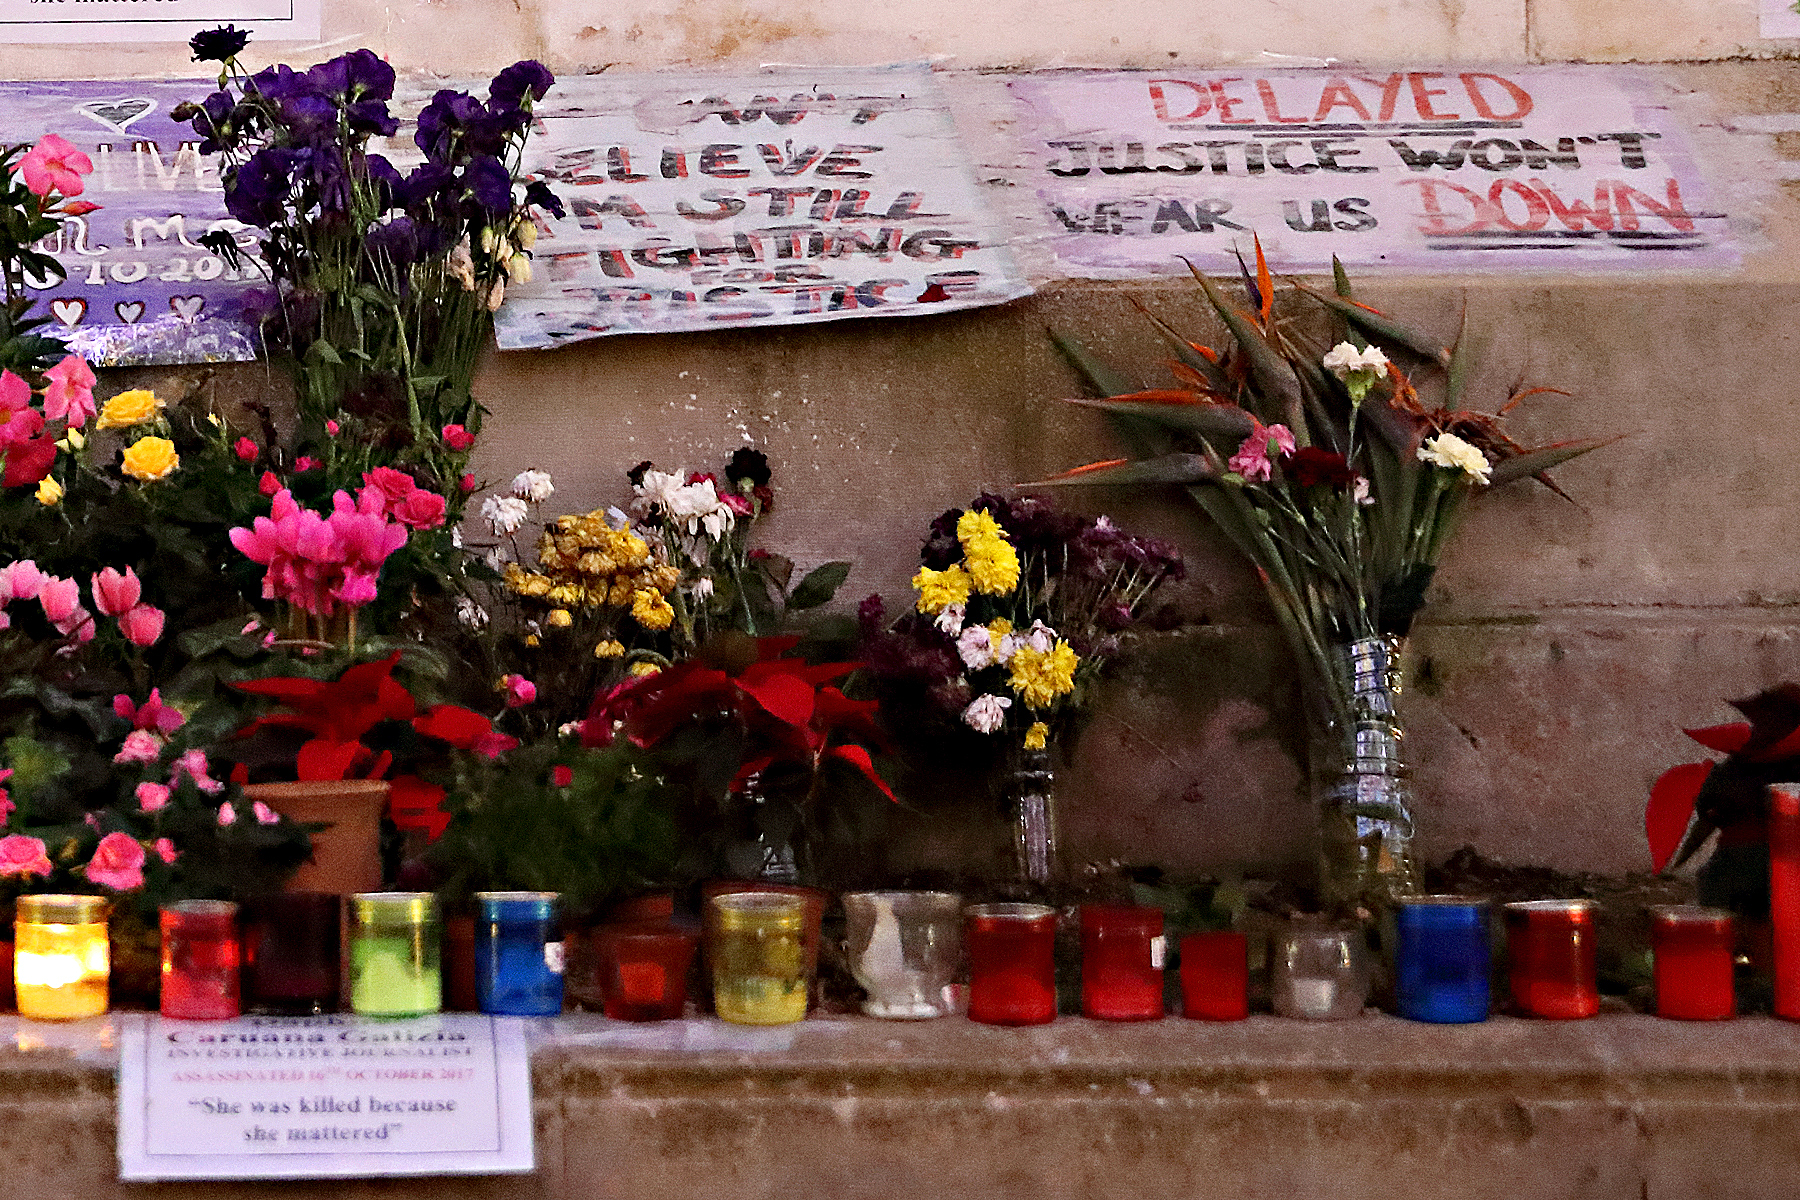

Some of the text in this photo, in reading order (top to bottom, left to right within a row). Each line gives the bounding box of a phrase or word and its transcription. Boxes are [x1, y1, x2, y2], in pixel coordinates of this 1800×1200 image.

[1148, 71, 1535, 123] DELAYED
[535, 143, 884, 187] ELIEVE
[1046, 132, 1661, 175] JUSTICE WON'T
[675, 187, 952, 223] STILL
[1283, 197, 1379, 232] US
[1398, 177, 1695, 236] DOWN
[250, 1101, 292, 1115] was
[299, 1096, 361, 1115] killed
[368, 1094, 458, 1114] because
[243, 1122, 278, 1142] she
